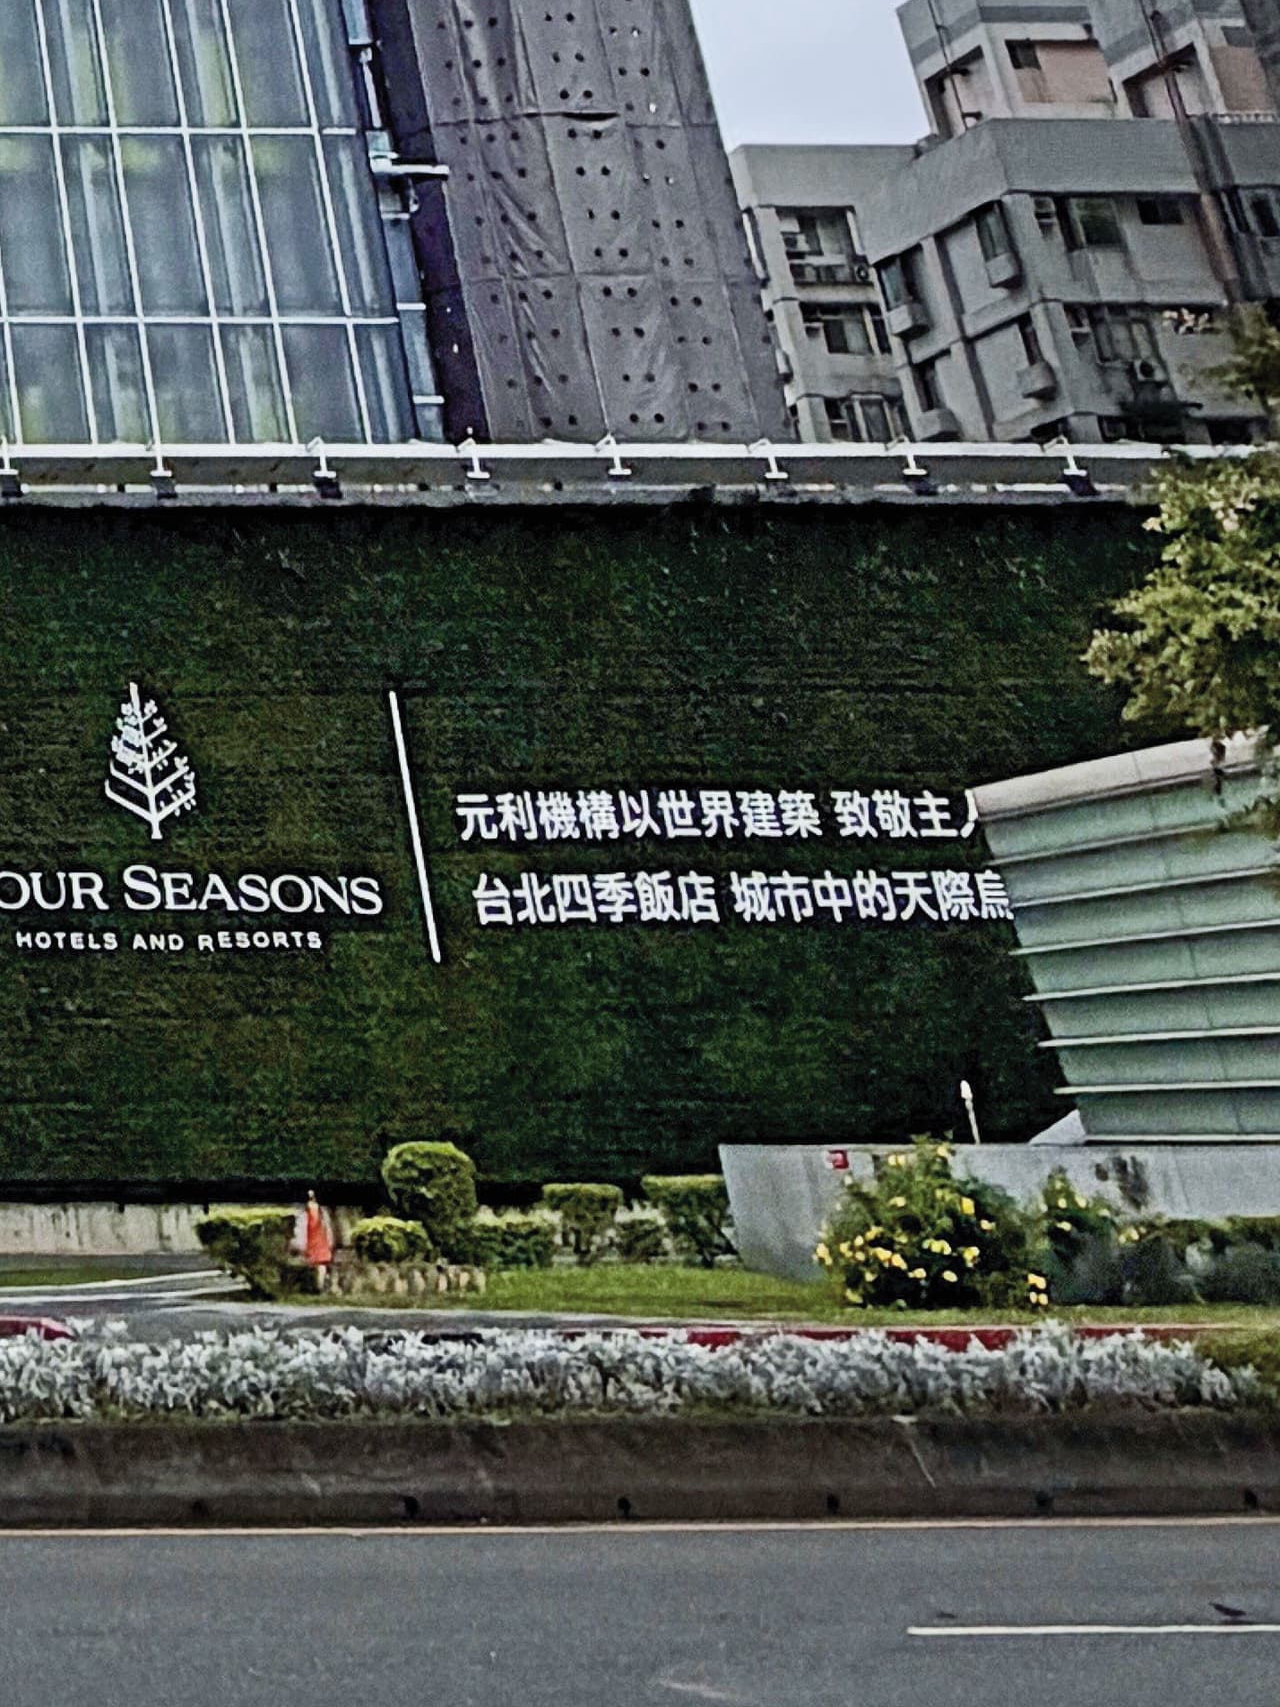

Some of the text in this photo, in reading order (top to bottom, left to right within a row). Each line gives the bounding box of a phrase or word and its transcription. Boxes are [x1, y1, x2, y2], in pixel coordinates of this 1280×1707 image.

[455, 789, 823, 841] 元利機構以世界建築
[122, 864, 384, 915] SEASONS
[471, 869, 721, 926] 台北四季飯店
[15, 930, 322, 952] HOTELS AND RESORTS
